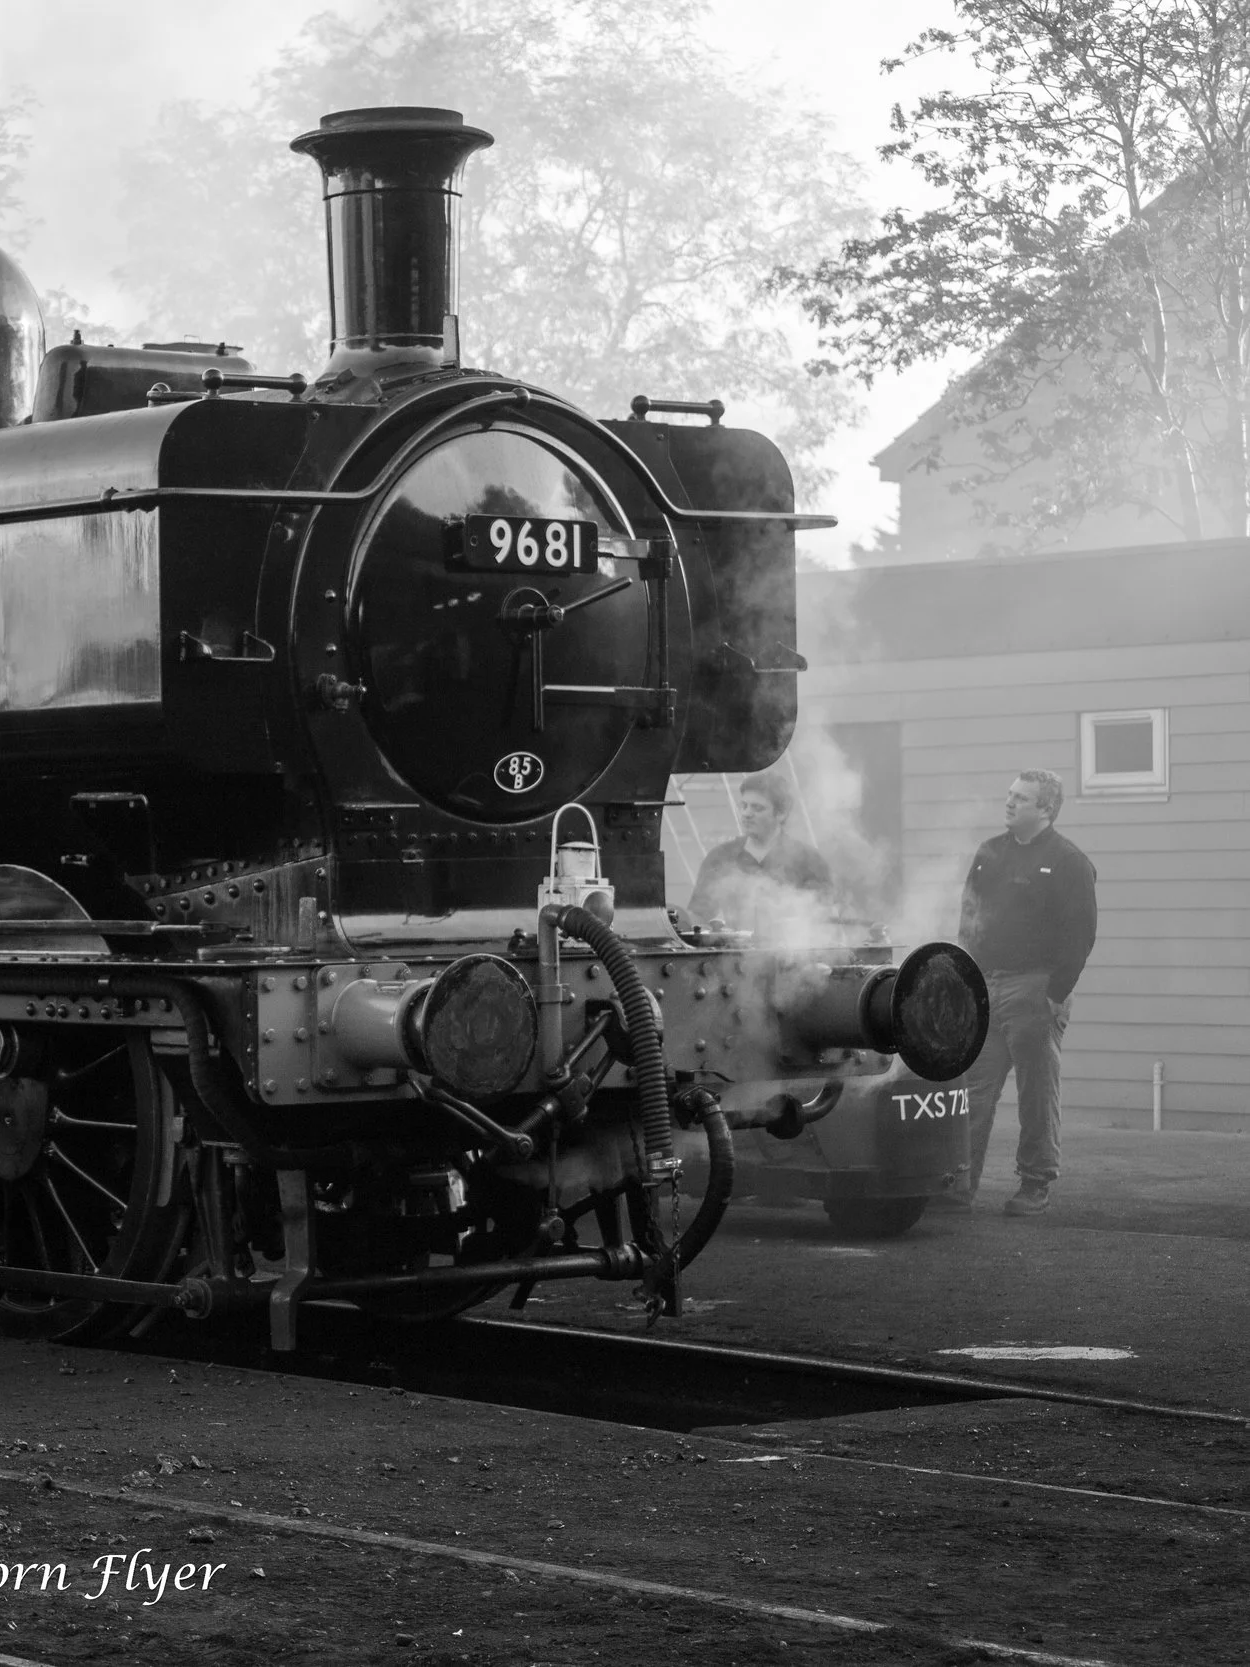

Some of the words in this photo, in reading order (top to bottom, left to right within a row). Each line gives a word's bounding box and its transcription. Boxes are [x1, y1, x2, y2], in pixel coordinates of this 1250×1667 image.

[489, 518, 581, 568] 9681
[508, 756, 532, 776] 85
[514, 773, 524, 790] B
[891, 1091, 947, 1121] TXS
